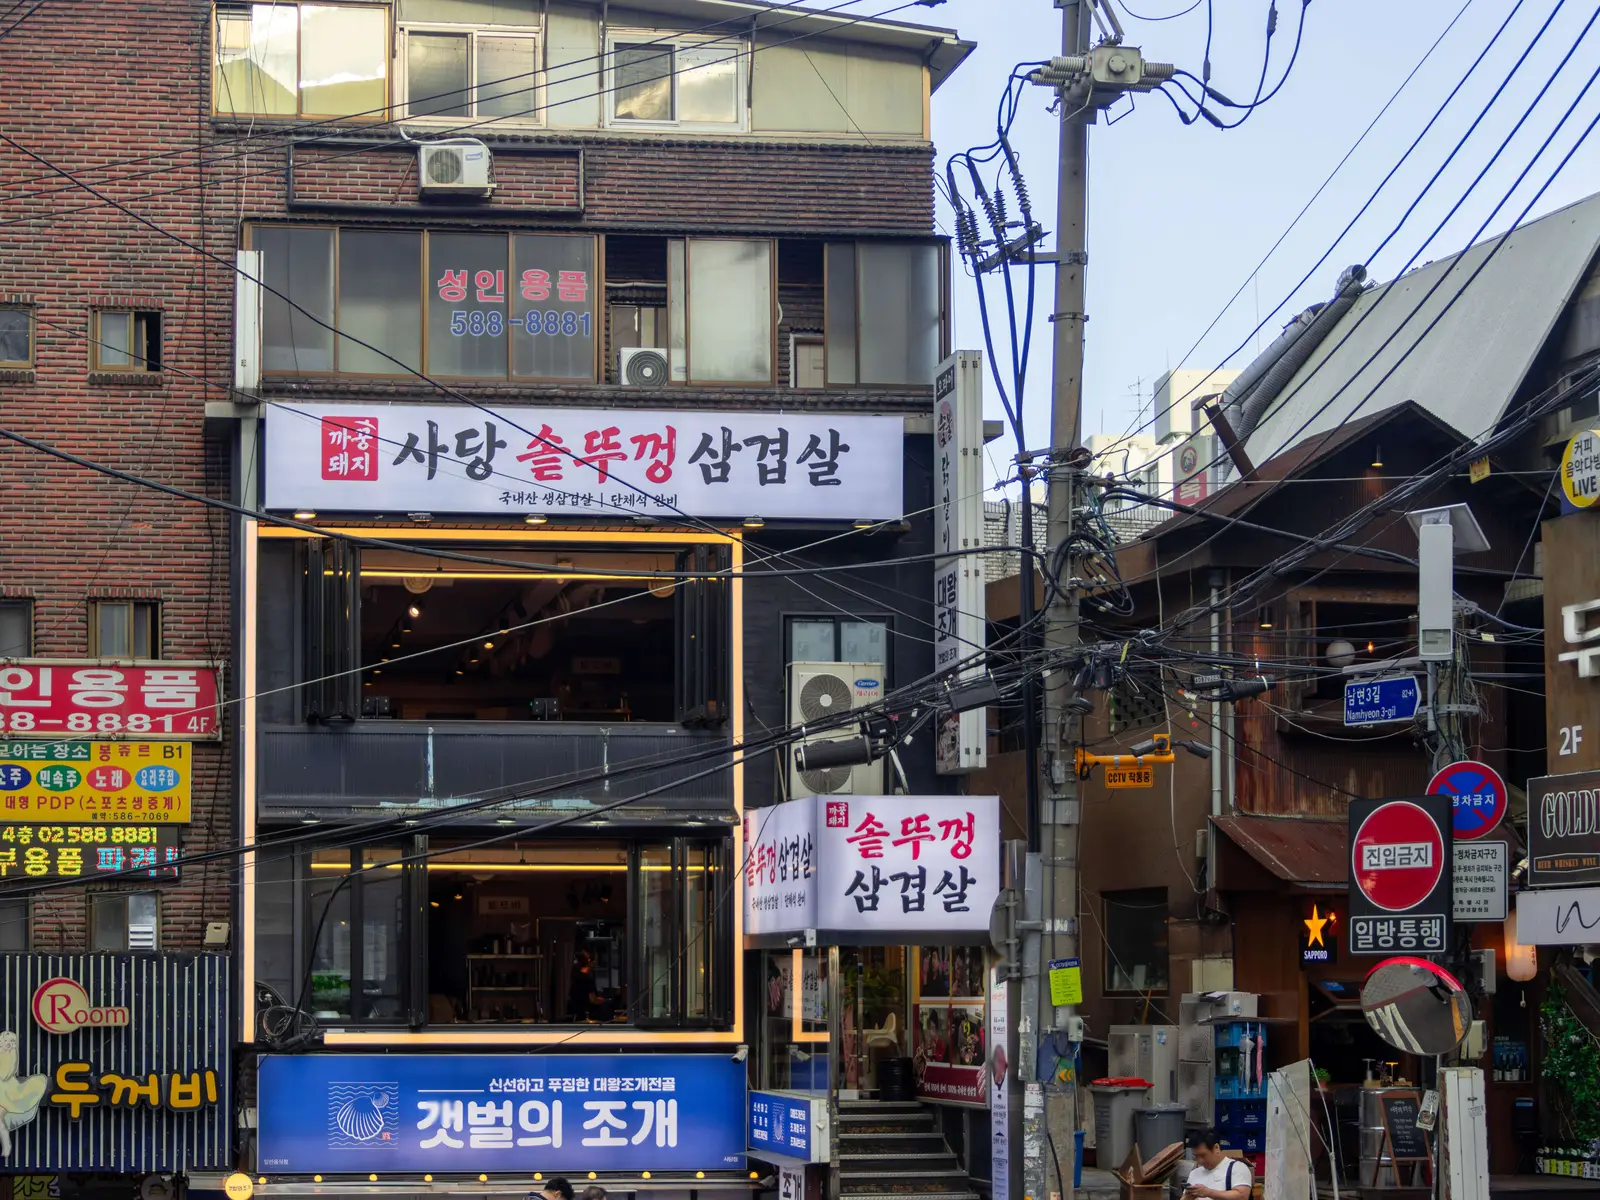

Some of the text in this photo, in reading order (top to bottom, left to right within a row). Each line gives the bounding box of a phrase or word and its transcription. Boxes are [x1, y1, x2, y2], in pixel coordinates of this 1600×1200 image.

[437, 269, 588, 303] 성인 용품
[450, 310, 591, 337] 588-8881
[392, 420, 850, 487] 사당 솥뚜껑 삼겹살
[1574, 436, 1593, 455] 커피
[328, 451, 370, 476] 돼지
[1572, 475, 1597, 498] LIVE
[498, 491, 678, 508] 국내산 생삼겹살 단체석 완비
[0, 667, 201, 708] 인용품
[1347, 685, 1380, 706] 남현3길
[0, 711, 210, 733] 8-8881 4F
[1347, 706, 1396, 722] Namhyeon 3-gil
[53, 744, 89, 759] 장소
[1559, 725, 1583, 756] 2F
[99, 744, 183, 762] 봉쥬르 B1
[40, 770, 77, 788] 민속주
[95, 770, 123, 788] 노래
[140, 770, 175, 787] 요리주점
[1107, 771, 1150, 783] CCTV 작동중
[5, 795, 29, 810] 대형
[2, 825, 33, 845] 4층
[111, 826, 157, 843] 8881
[846, 812, 976, 860] 솥뚜껑
[745, 831, 813, 887] 솥뚜껑 삼겹살
[1366, 845, 1428, 867] 진입금지
[1453, 848, 1498, 860] ·정차금지구간
[844, 865, 977, 913] 삼겹살
[1355, 919, 1441, 948] 일방통행
[1303, 950, 1328, 960] SAPPORO
[47, 994, 126, 1025] Room
[50, 1062, 218, 1119] 두꺼비
[489, 1077, 676, 1092] 신선하고 푸짐한 대왕조개전골
[417, 1099, 678, 1149] 갯벌의 조개
